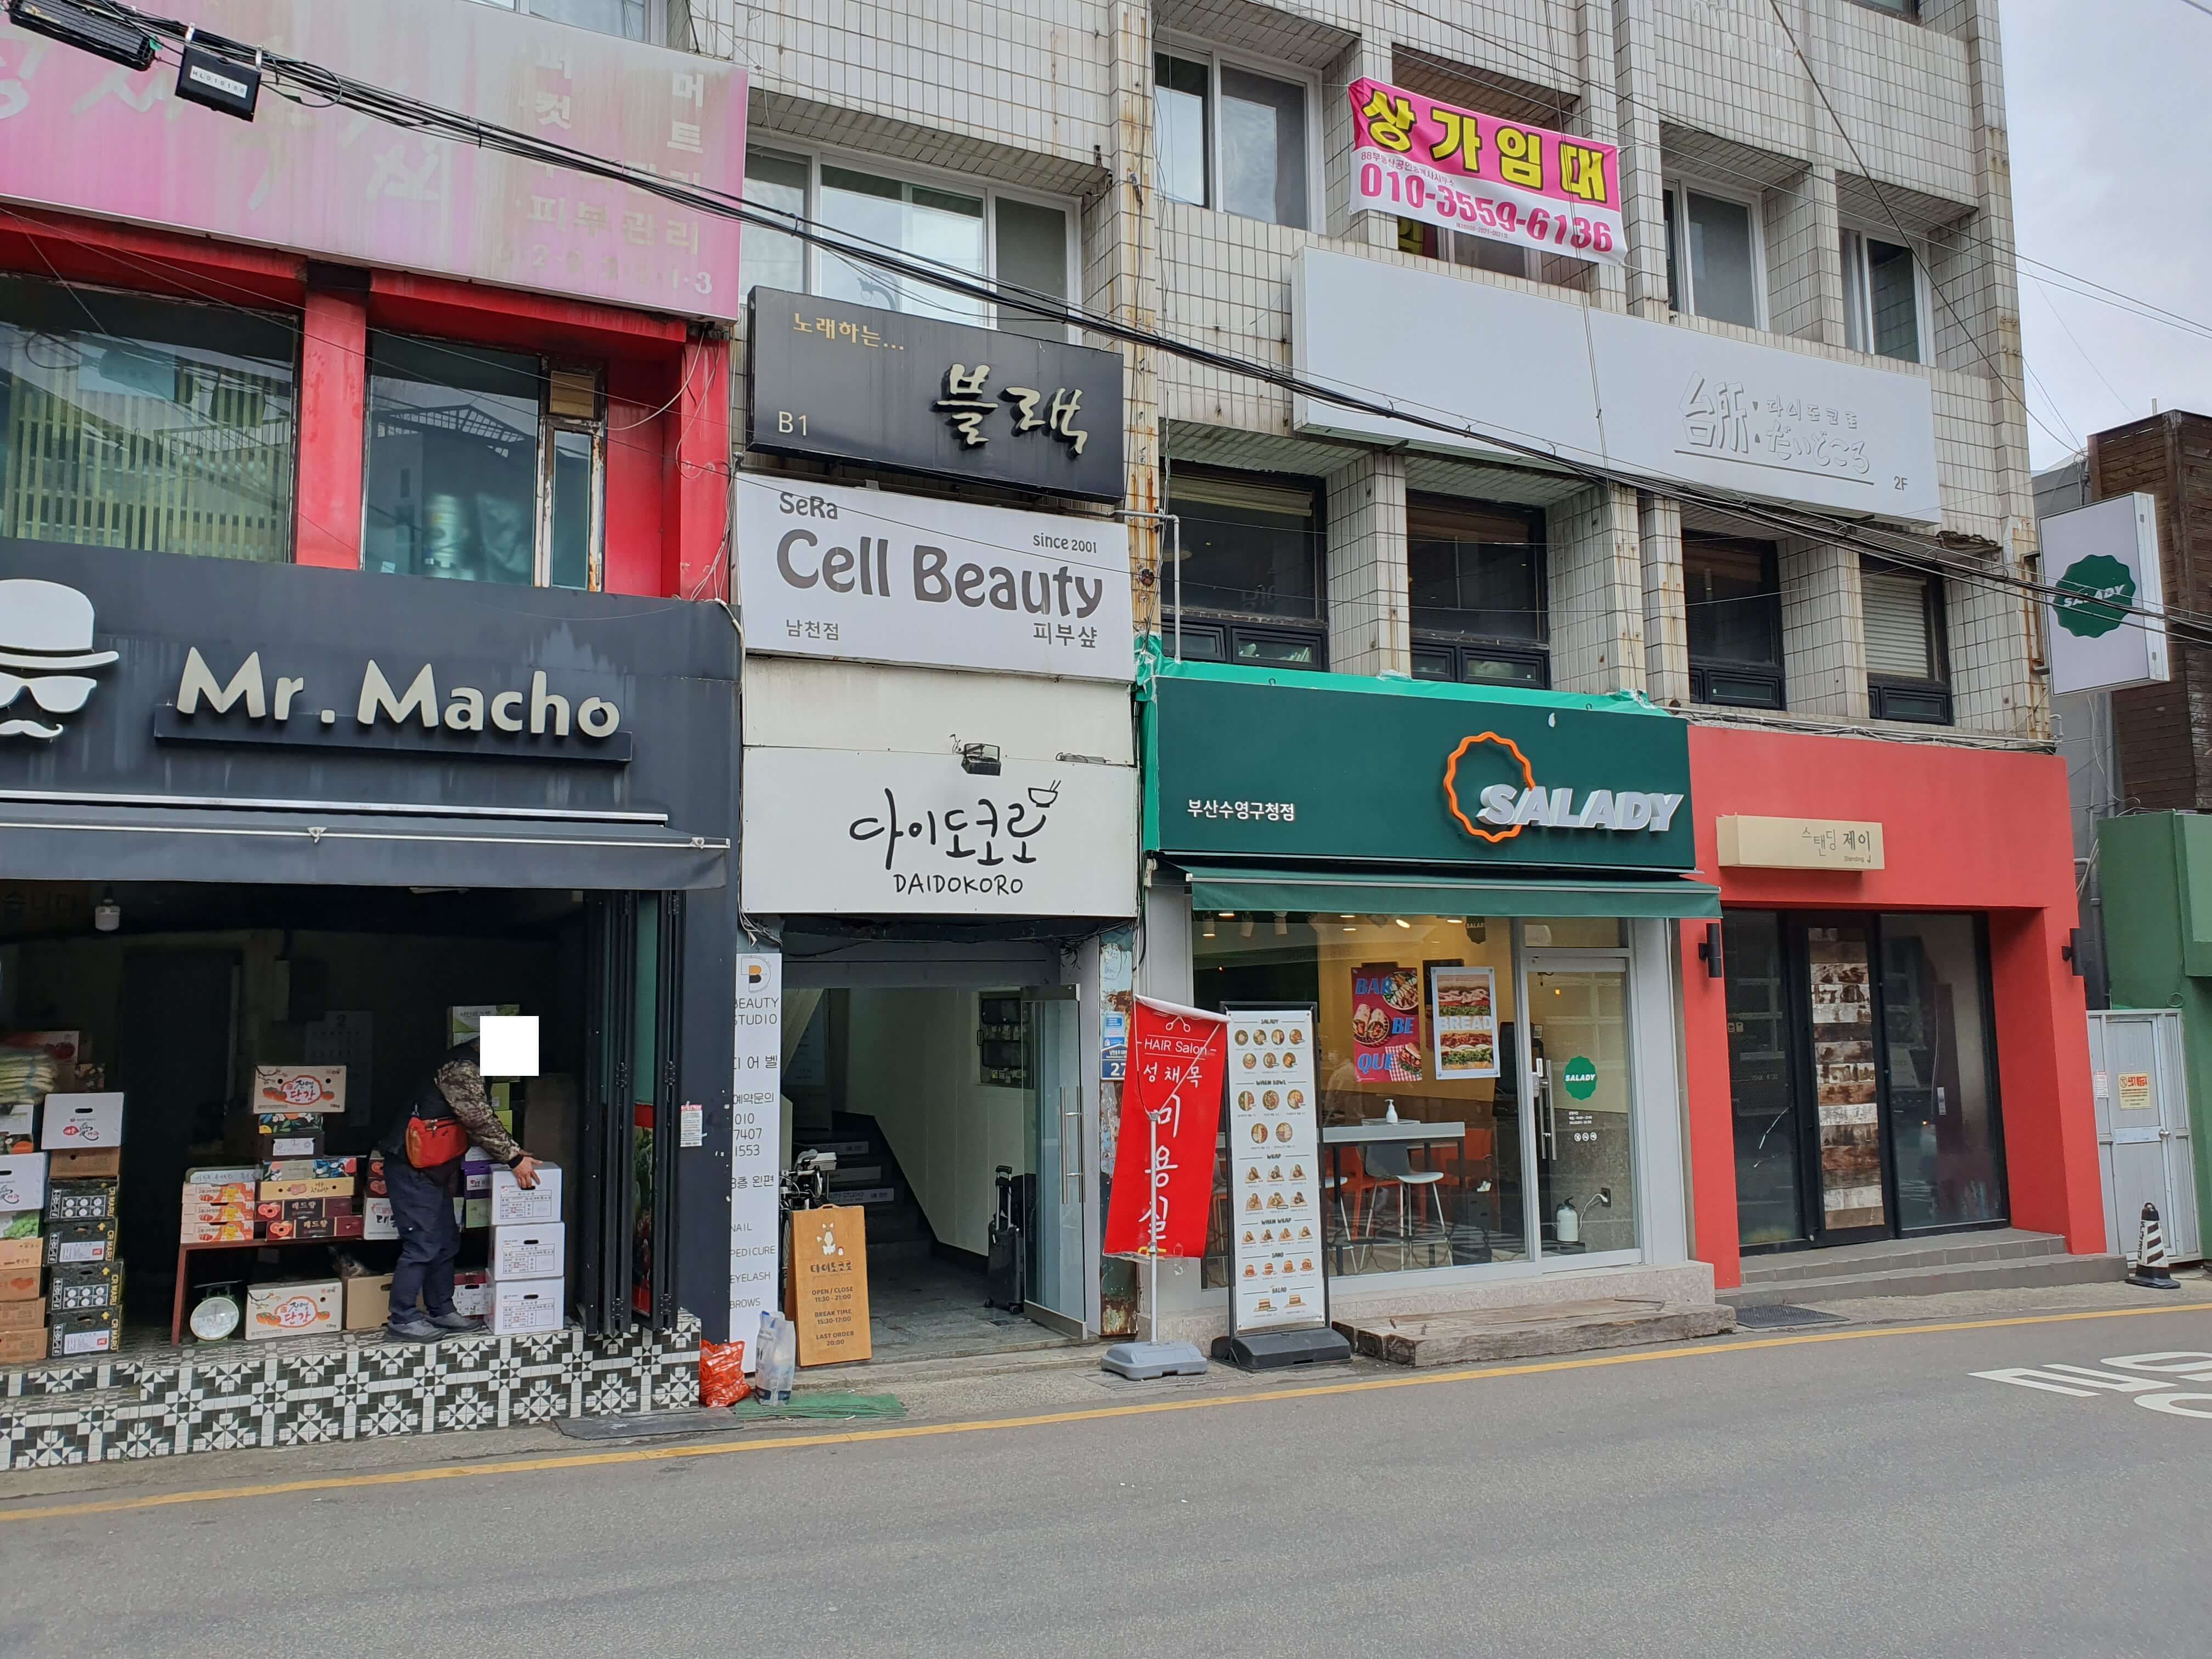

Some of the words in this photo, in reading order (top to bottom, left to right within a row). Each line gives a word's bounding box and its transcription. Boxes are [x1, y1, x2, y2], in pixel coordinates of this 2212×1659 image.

[1362, 90, 1607, 203] 상가임대
[1361, 163, 1613, 252] 010-3559-6136
[936, 363, 1088, 455] 블랙
[778, 410, 808, 436] B1
[1894, 476, 1908, 491] 2F
[779, 493, 838, 520] SeRa
[1033, 533, 1068, 549] since
[1071, 539, 1097, 554] 2001
[777, 529, 890, 597] Cell
[913, 544, 1103, 619] Beauty
[786, 619, 839, 641] 남천점
[1033, 622, 1097, 648] 피부샾
[357, 659, 621, 737] Macho
[1187, 798, 1296, 821] 부산수영구청점
[1476, 783, 1684, 832] SALADY
[849, 787, 1046, 870] 다이도코로
[1802, 826, 1836, 856] 스탠딩
[1843, 830, 1871, 851] 제이
[1867, 855, 1871, 864] J
[894, 873, 1023, 895] DAIDOKORO
[1392, 1018, 1415, 1034] BE
[1438, 1016, 1493, 1030] BREAD
[1144, 1039, 1171, 1052] HAIR
[1175, 1042, 1207, 1055] Salon
[1358, 1053, 1396, 1073] QUE
[290, 1090, 316, 1101] 단감
[733, 1092, 774, 1104] 예약문의
[735, 1113, 755, 1125] 010
[733, 1128, 762, 1140] 7407
[735, 1144, 760, 1156] 1553
[752, 1175, 774, 1187] 왼편
[731, 1223, 752, 1232] NAIL
[730, 1245, 776, 1257] PEDICURE
[810, 1260, 853, 1273] 다이도코로
[730, 1272, 771, 1284] EYELASH
[730, 1297, 761, 1309] BROWS
[284, 1311, 311, 1324] 단감
